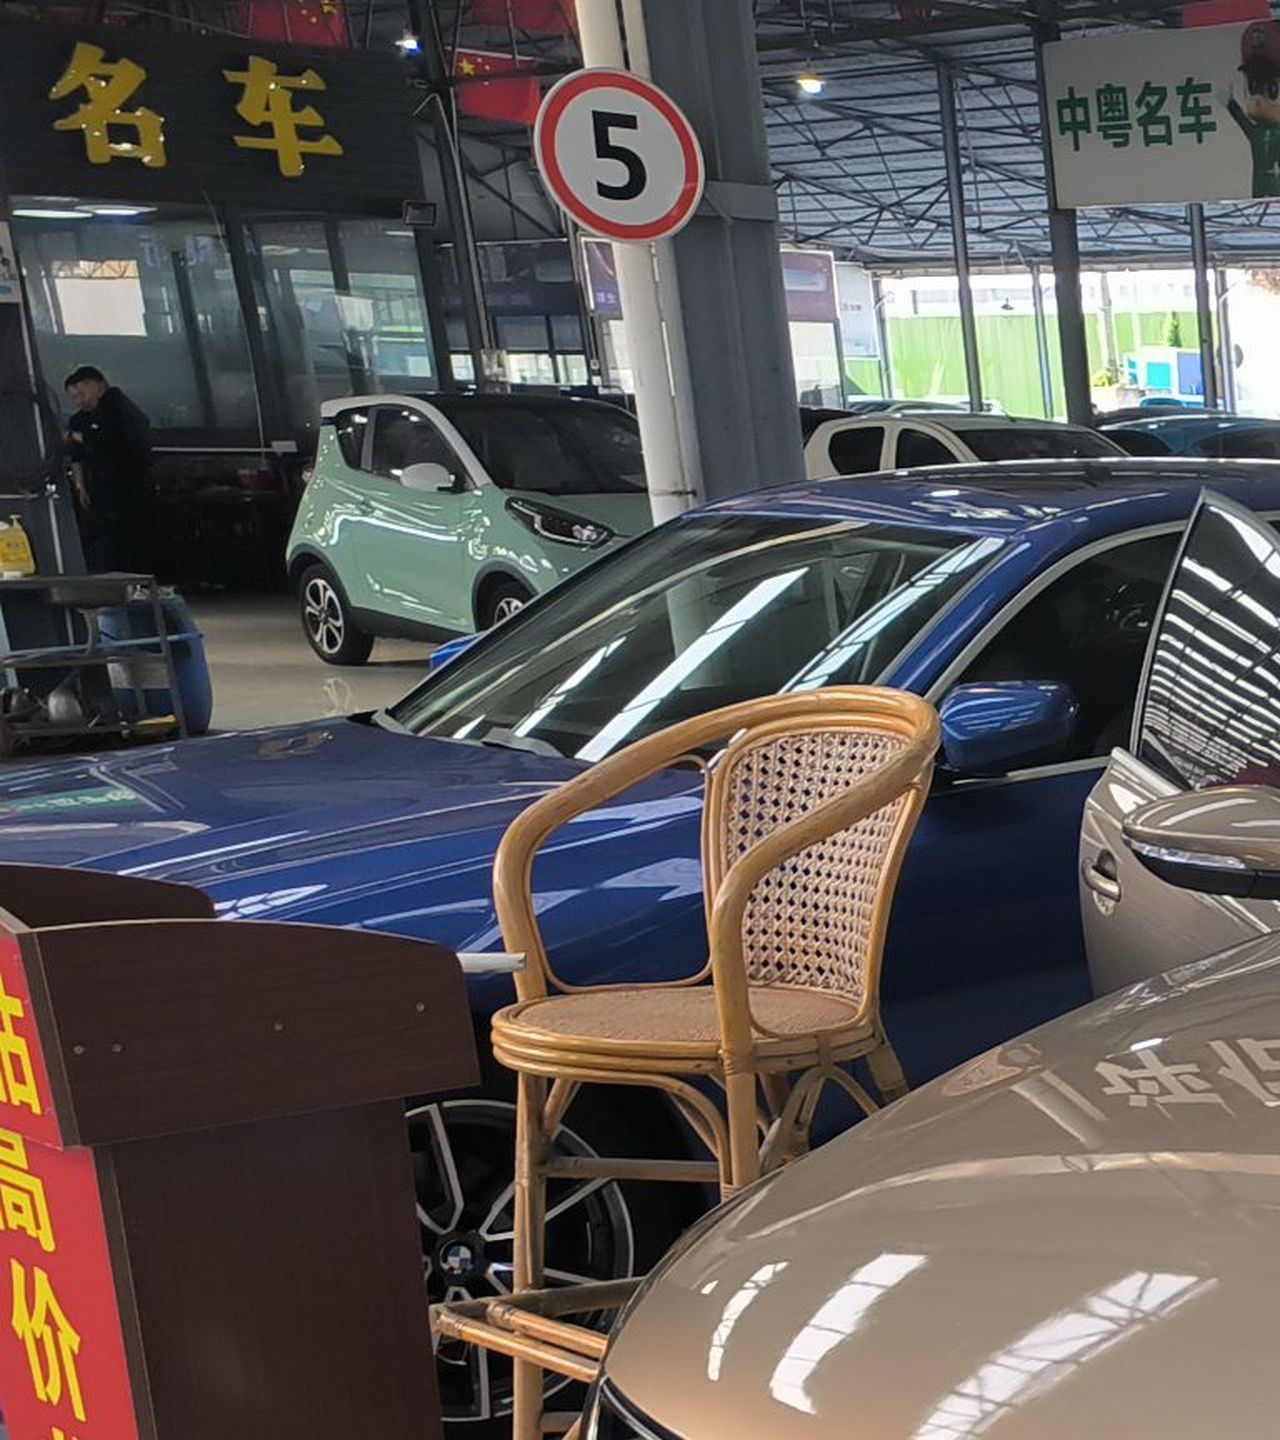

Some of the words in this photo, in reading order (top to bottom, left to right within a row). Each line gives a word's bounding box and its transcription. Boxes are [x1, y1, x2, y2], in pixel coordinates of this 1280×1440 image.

[50, 42, 343, 178] 名车
[591, 110, 648, 200] 5
[1057, 77, 1217, 152] 中粤名车
